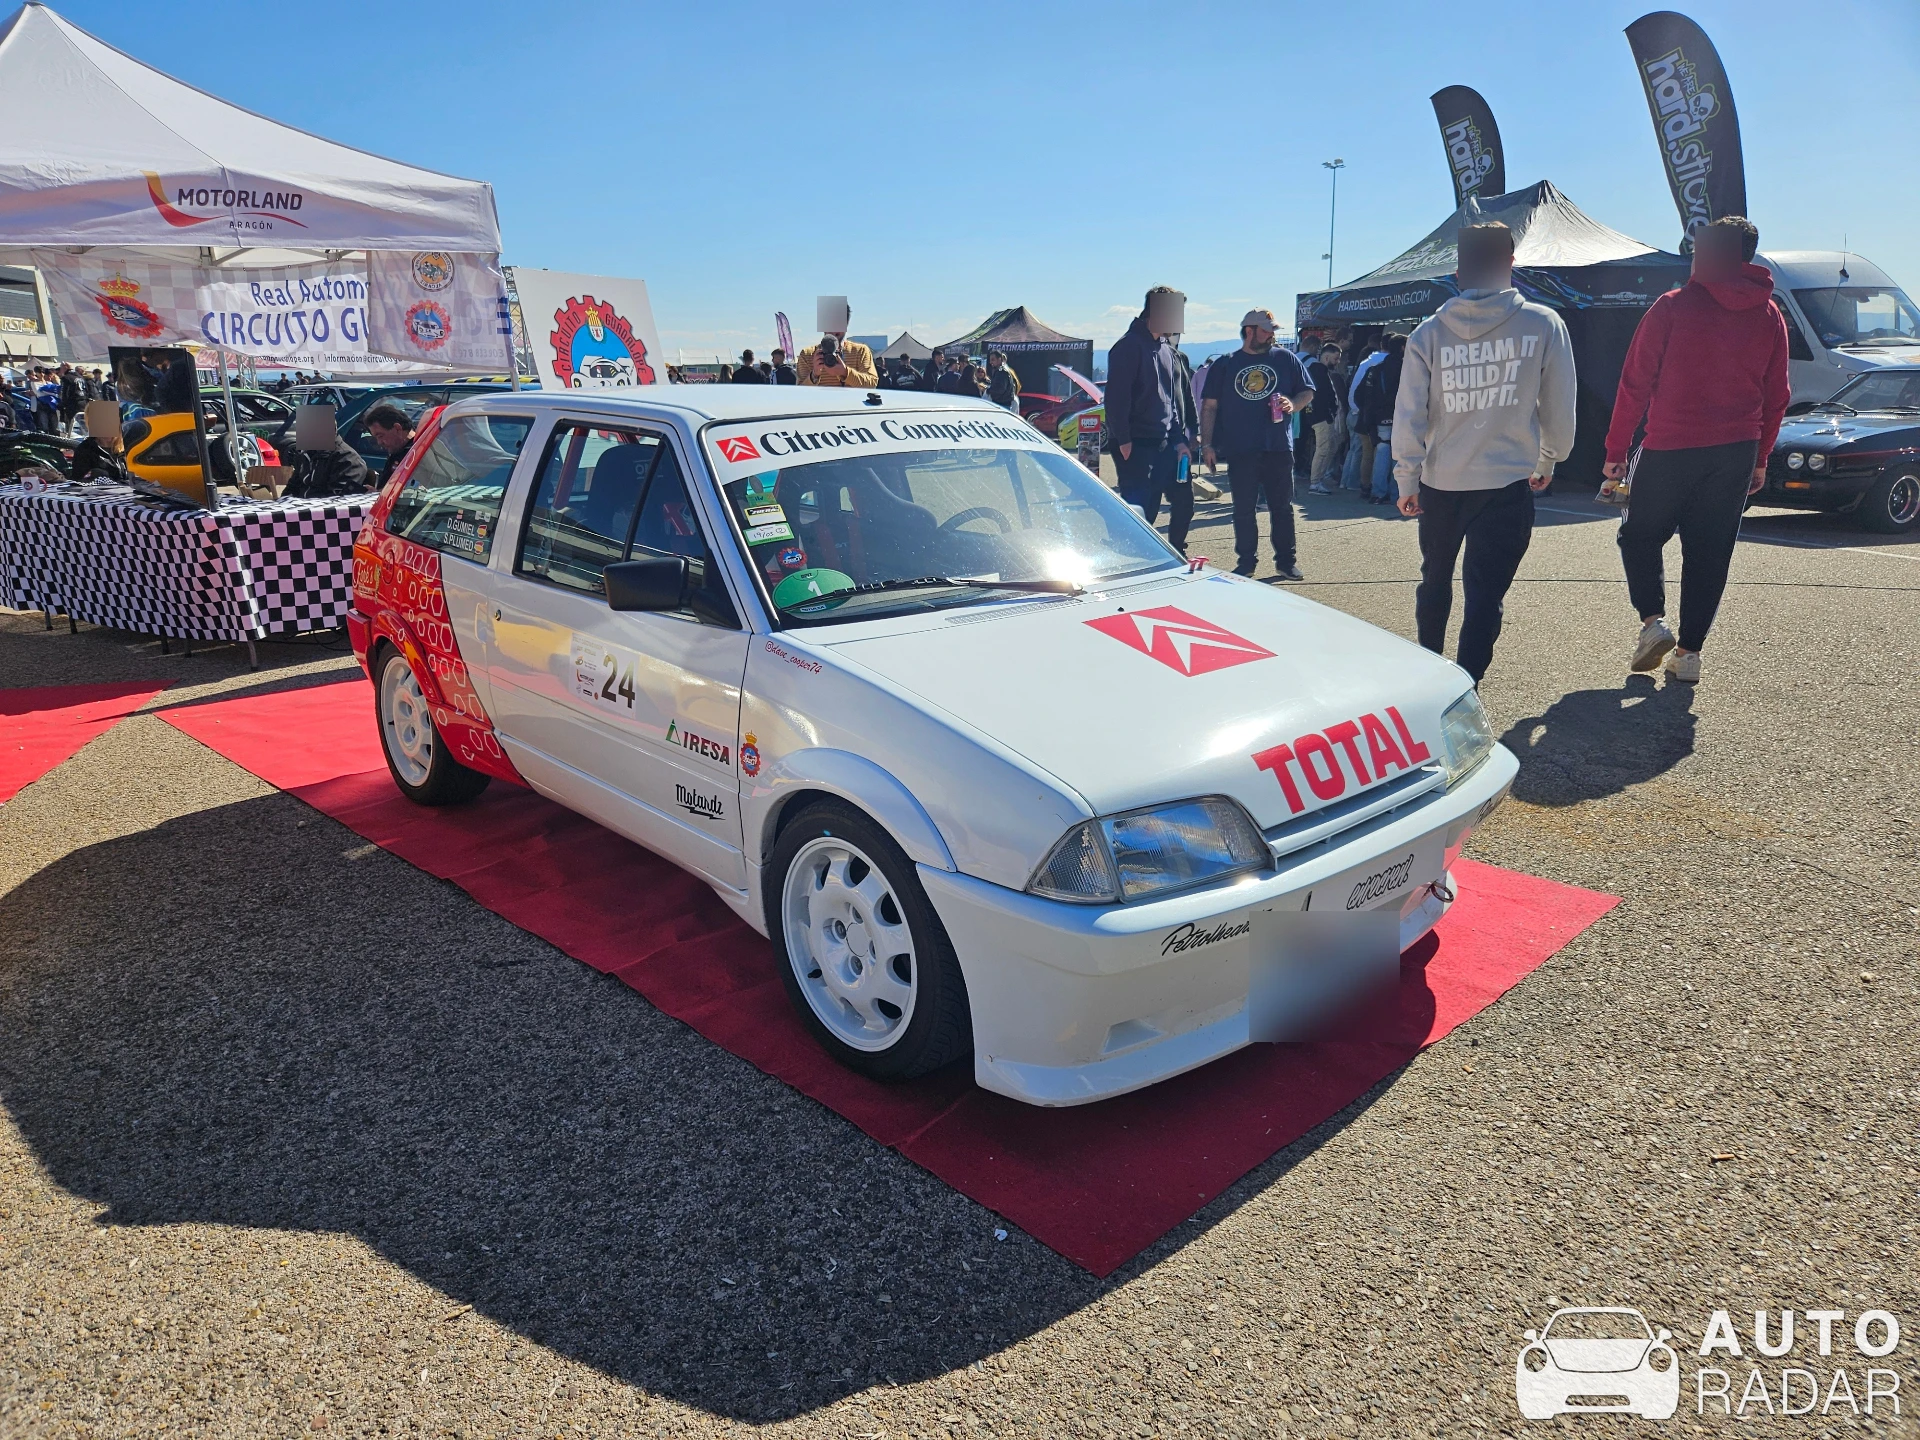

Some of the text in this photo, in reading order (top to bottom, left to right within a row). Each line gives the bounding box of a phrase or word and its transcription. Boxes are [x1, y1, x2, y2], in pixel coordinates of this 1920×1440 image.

[177, 188, 303, 211] MOTORLAND
[229, 220, 273, 230] ARAGÓN
[250, 279, 295, 307] Real
[1337, 289, 1431, 313] HARDESTCLOTHING.COM
[201, 308, 330, 346] CIRCUITO
[605, 313, 647, 374] GUADALOPE
[987, 341, 1088, 352] PEGATINAS PERSONALIZADAS
[1440, 335, 1539, 369] DREAM IT
[1441, 360, 1522, 391] BUILD IT
[1498, 384, 1519, 407] IT.
[759, 419, 1044, 456] Citroën Compétitions
[447, 518, 475, 537] D.GUMIEL
[443, 535, 473, 552] S.PLUMED
[807, 580, 824, 597] 1
[601, 653, 636, 709] 24
[1250, 705, 1431, 815] TOTAL
